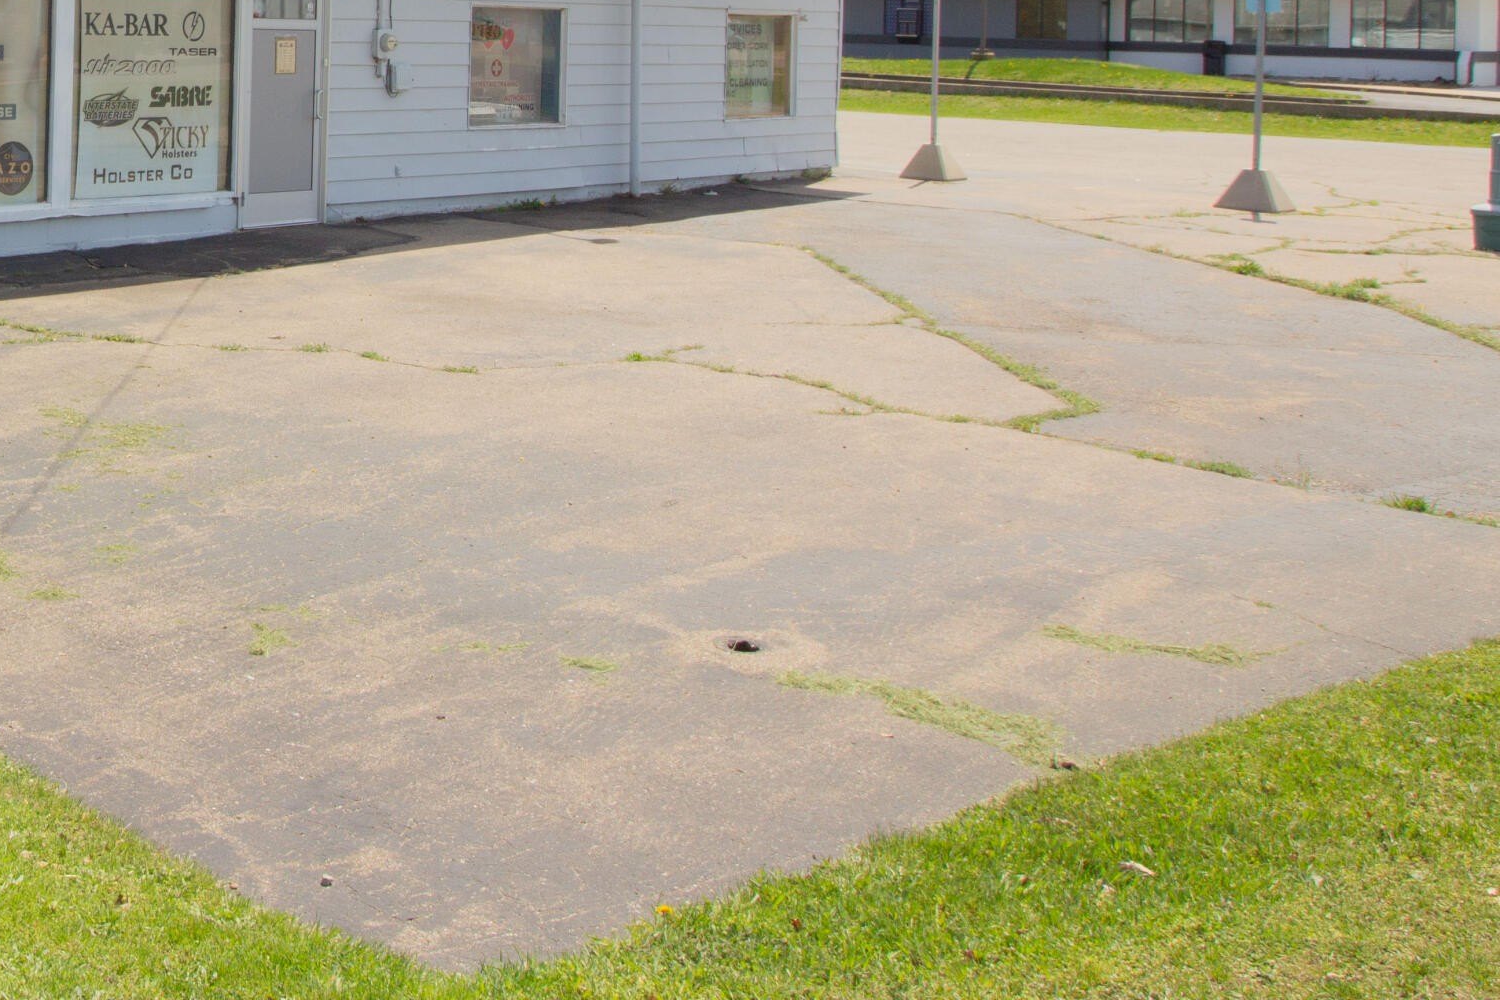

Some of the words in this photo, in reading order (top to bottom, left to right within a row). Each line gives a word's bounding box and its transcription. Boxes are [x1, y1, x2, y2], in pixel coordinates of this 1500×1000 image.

[84, 12, 169, 36] KA-BAR
[169, 48, 217, 56] TASER
[148, 85, 212, 107] SABRE
[84, 101, 138, 110] INTERSTATE
[85, 111, 133, 120] BATTERIES
[141, 120, 209, 150] STICKY
[162, 149, 197, 159] Holsters
